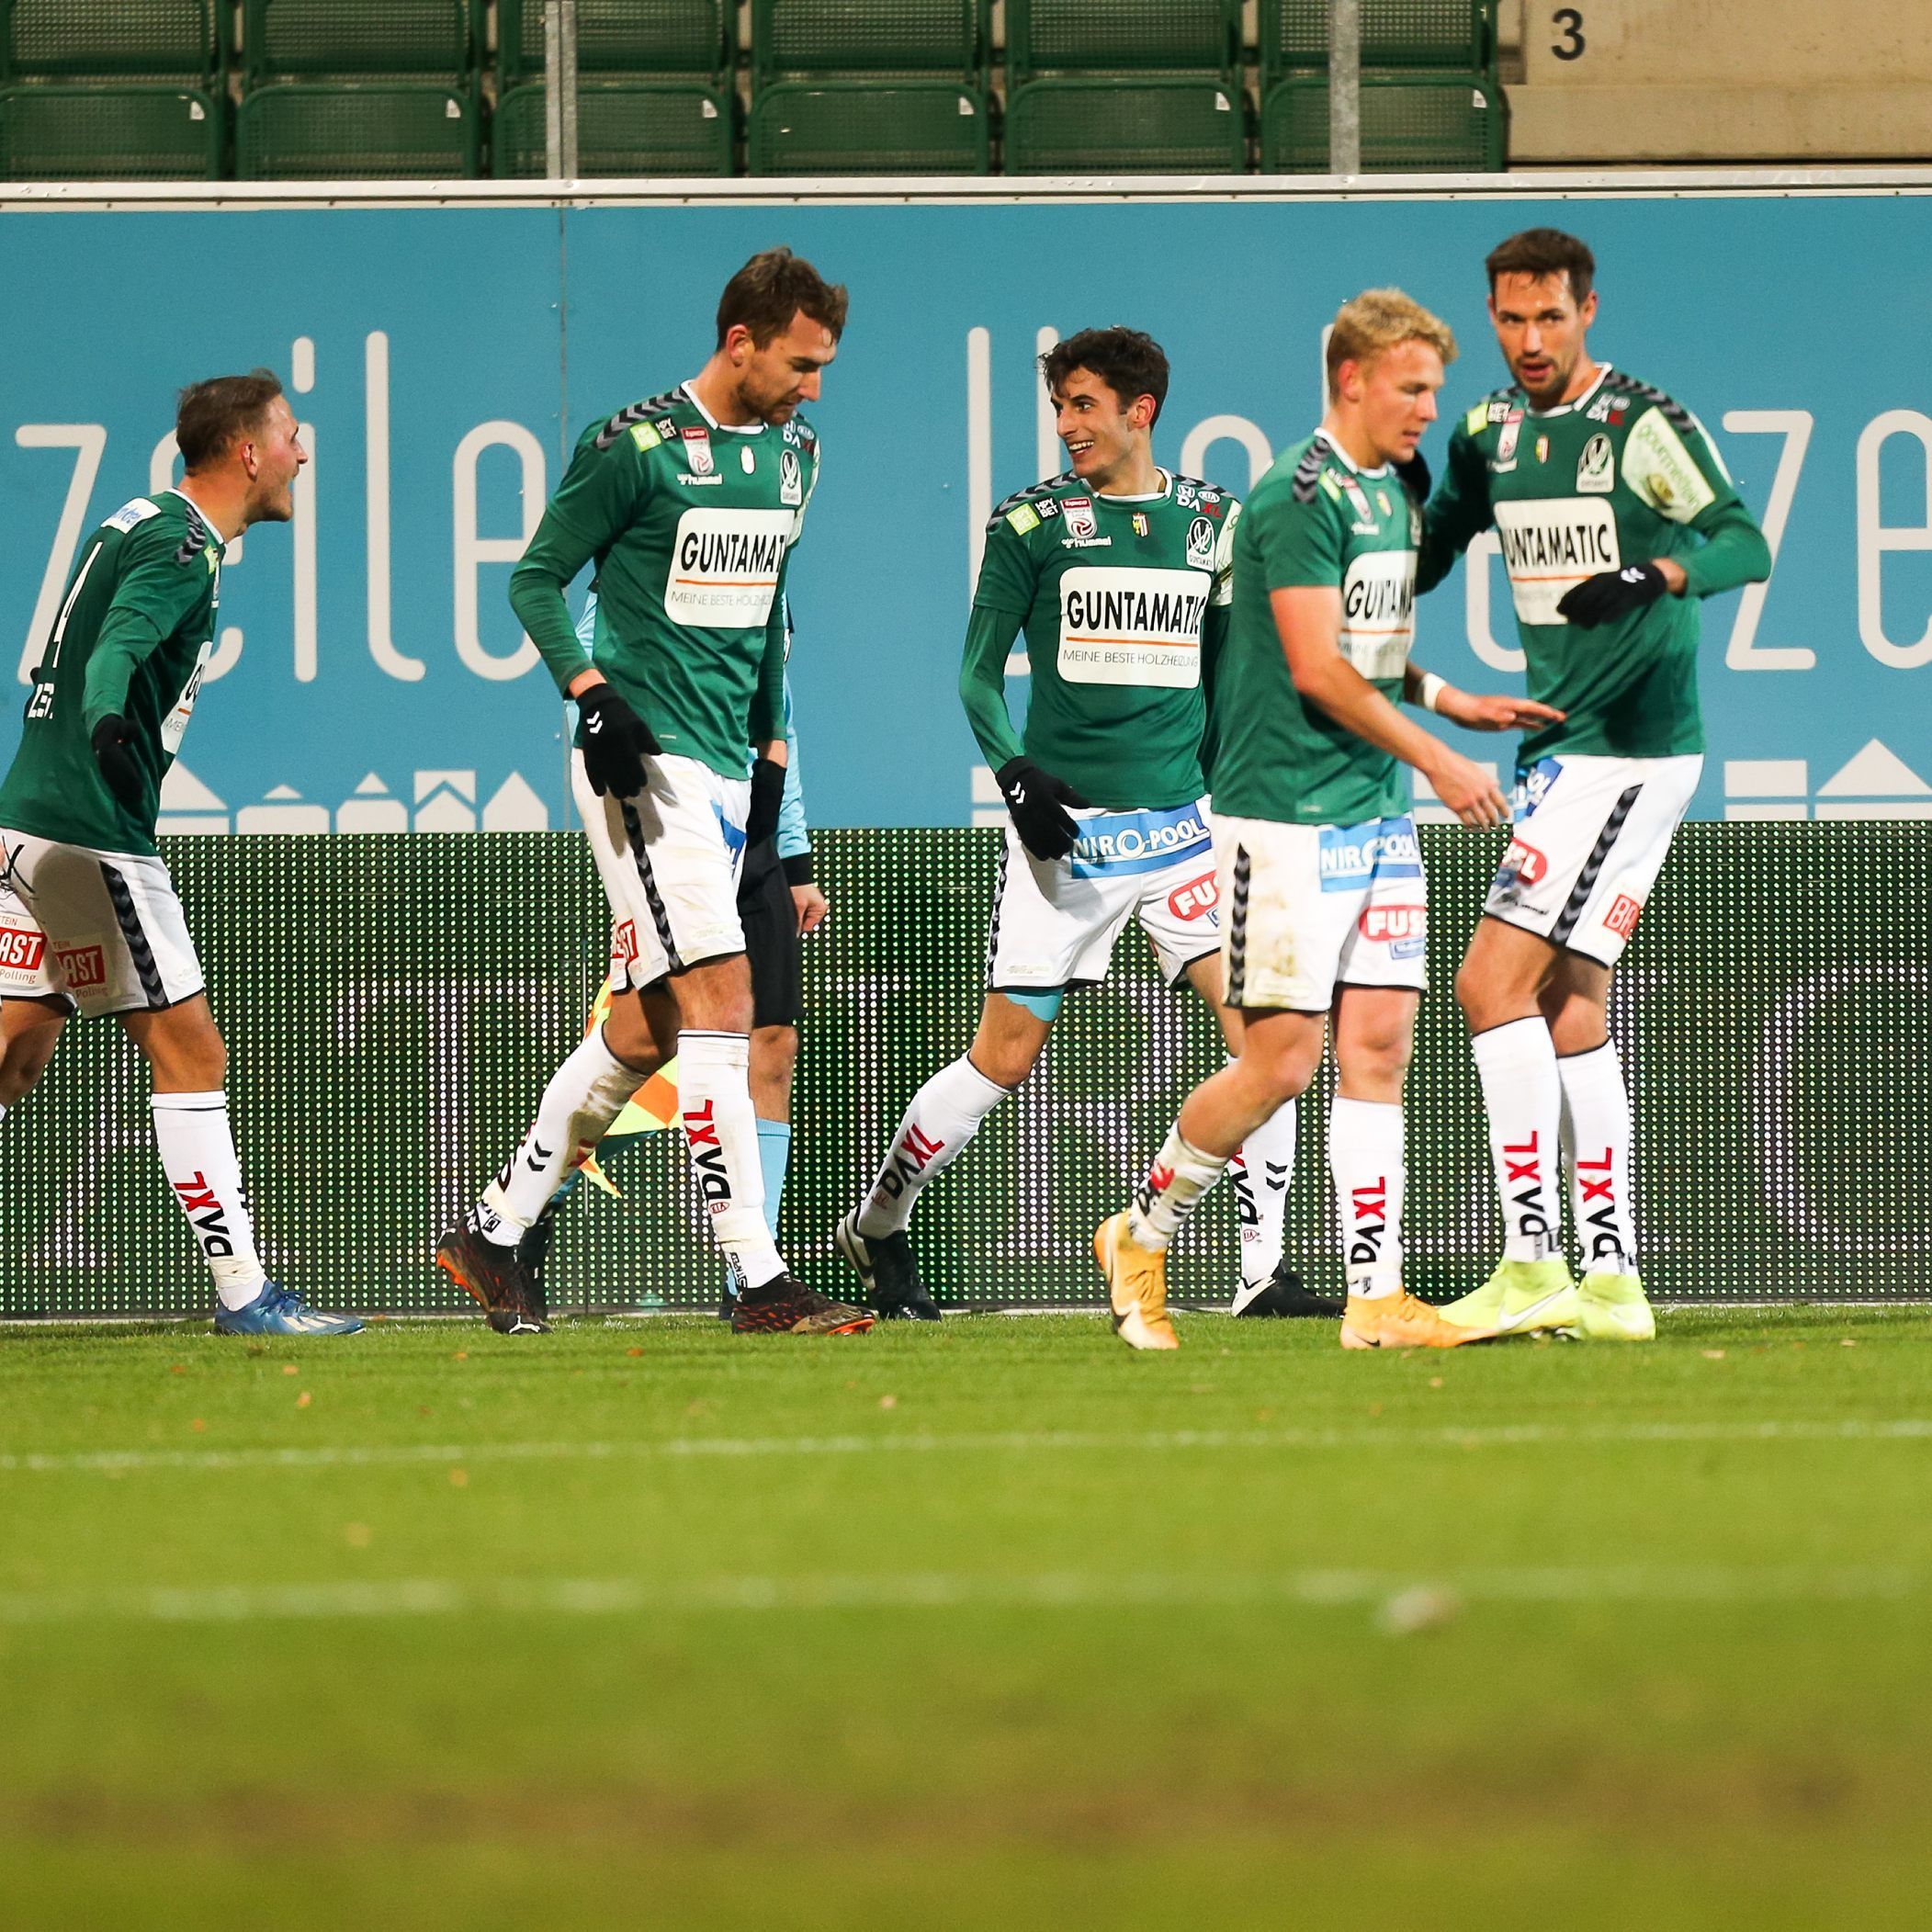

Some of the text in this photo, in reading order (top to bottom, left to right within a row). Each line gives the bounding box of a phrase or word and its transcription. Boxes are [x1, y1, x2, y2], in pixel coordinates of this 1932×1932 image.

[1551, 8, 1587, 61] 3
[1063, 649, 1101, 663] MEINE
[1104, 651, 1135, 664] BESTE
[683, 1099, 732, 1200] DAXL
[876, 1123, 945, 1201] DAXL
[1503, 1131, 1549, 1236] DAXL
[174, 1171, 234, 1258] DAXL
[1350, 1176, 1385, 1264] DAXL
[1576, 1147, 1624, 1261] DAXL
